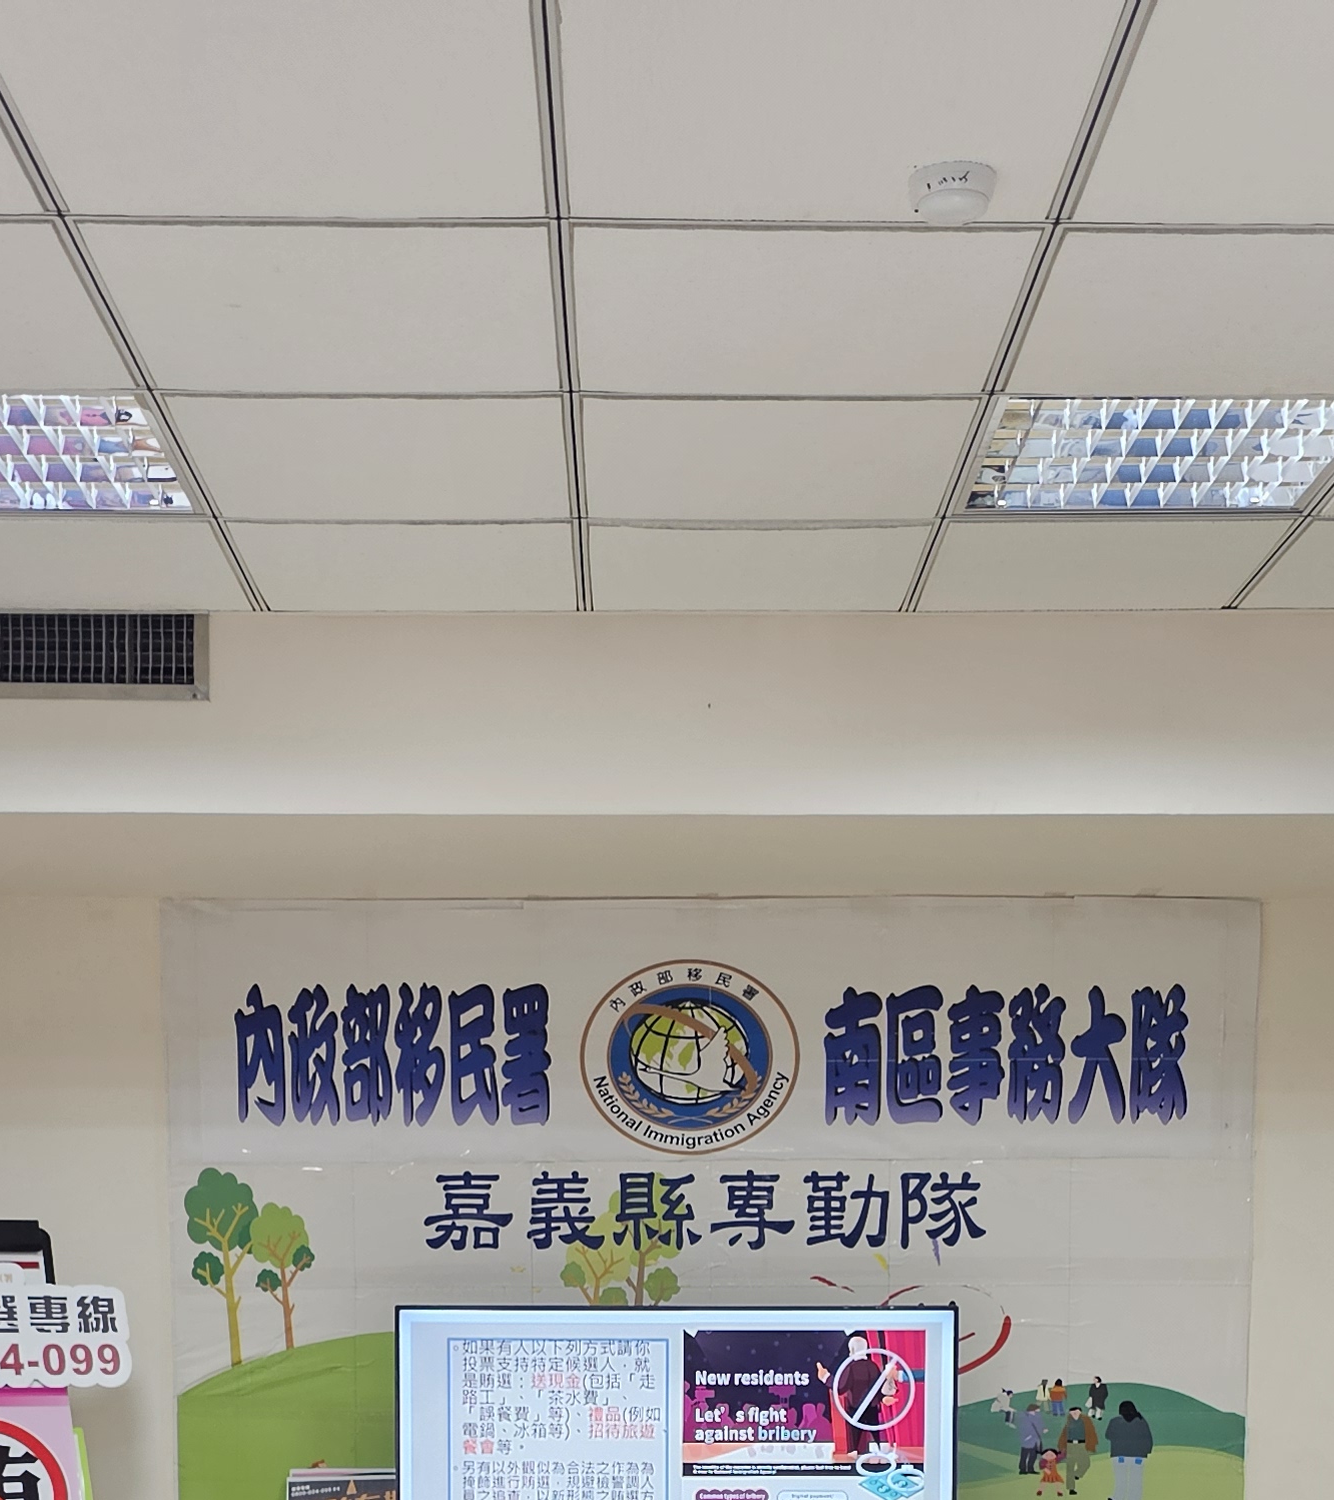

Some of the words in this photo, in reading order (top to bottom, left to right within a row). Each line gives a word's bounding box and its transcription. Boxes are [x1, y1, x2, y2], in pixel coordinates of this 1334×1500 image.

[823, 983, 1190, 1126] 南區事務大隊
[593, 1074, 643, 1132] National
[643, 1123, 746, 1149] Immigration
[746, 1071, 790, 1126] Agency
[424, 1170, 988, 1251] 嘉義縣專勤隊
[695, 1370, 730, 1386] New
[734, 1369, 810, 1386] residents
[694, 1426, 755, 1445] against
[757, 1426, 817, 1444] bribery
[748, 1406, 787, 1425] fight
